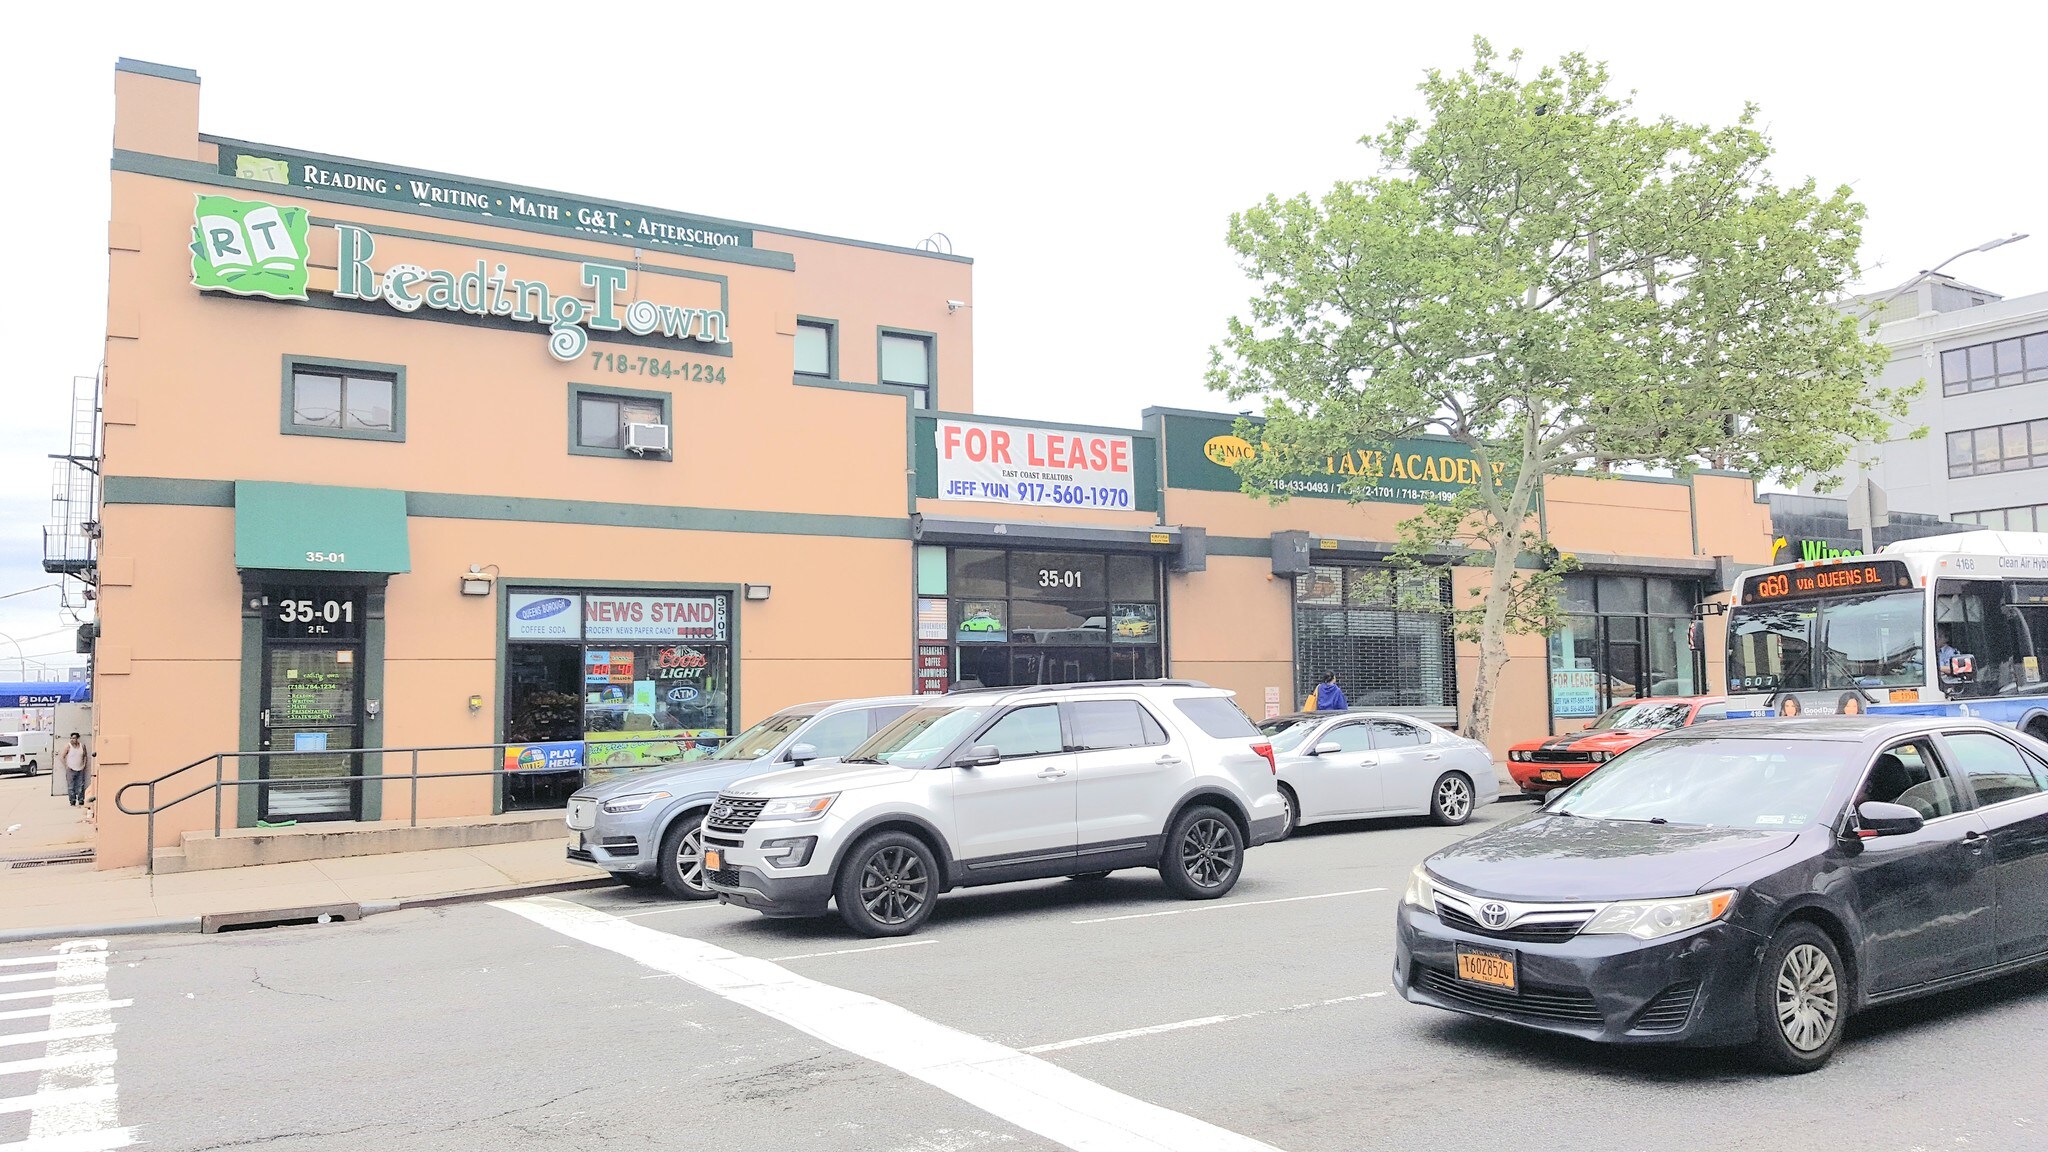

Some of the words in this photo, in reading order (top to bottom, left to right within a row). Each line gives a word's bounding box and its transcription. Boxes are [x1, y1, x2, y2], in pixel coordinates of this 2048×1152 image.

[303, 165, 387, 194] READING
[409, 181, 489, 208] WRITING
[509, 195, 559, 220] MATH
[577, 208, 618, 229] G&T
[591, 351, 726, 384] 718-784-1234
[943, 425, 1012, 465] FOR
[1026, 432, 1128, 473] LEASE
[1002, 469, 1018, 479] EAST
[1020, 470, 1040, 481] COAST
[1041, 472, 1073, 483] REALTORS
[946, 480, 977, 496] JEFF
[981, 482, 1009, 499] YUN
[1017, 482, 1128, 508] 917-560-1970
[306, 551, 345, 564] 35-01
[1955, 557, 1975, 571] 4168
[1998, 556, 2019, 569] Clean
[2020, 557, 2031, 570] Air
[1039, 569, 1082, 588] 35-01
[1759, 574, 1789, 599] Q60
[1797, 578, 1814, 591] VIA
[1817, 568, 1862, 588] QUEENS
[1865, 567, 1881, 583] BL
[279, 600, 353, 623] 35-01
[585, 601, 643, 622] NEWS
[650, 603, 714, 623] STAND
[308, 625, 315, 634] 2
[521, 625, 545, 634] COFFEE
[549, 626, 566, 634] SODA
[615, 626, 634, 635] NEWS
[634, 627, 654, 635] PAPER
[655, 627, 675, 635] CANDY
[919, 646, 945, 655] BREAKFAST
[659, 648, 708, 668] Coors
[925, 657, 941, 667] COFFEE
[660, 668, 705, 679] LIGHT
[1553, 673, 1568, 688] FOR
[1571, 673, 1594, 688] LEASE
[925, 679, 941, 689] SODAS
[674, 689, 694, 699] ATM
[550, 749, 576, 759] PLAY
[1463, 955, 1509, 980] T602852C
